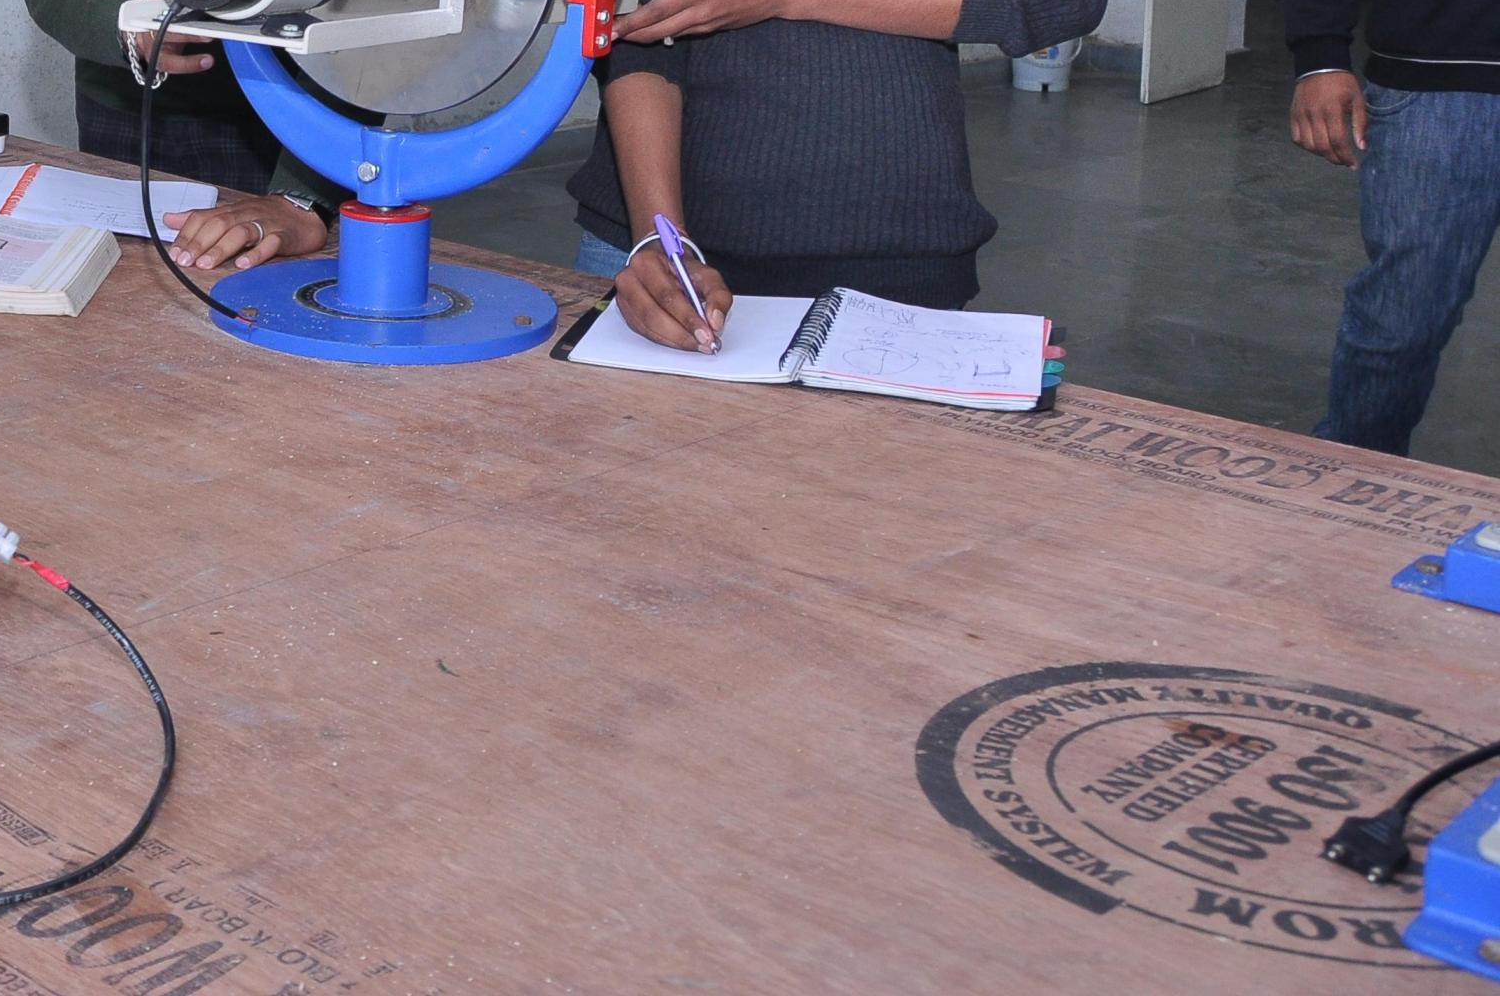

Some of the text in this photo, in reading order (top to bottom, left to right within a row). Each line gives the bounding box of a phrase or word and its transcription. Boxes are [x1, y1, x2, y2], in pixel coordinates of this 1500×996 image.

[1123, 431, 1323, 490] WOOD
[1135, 457, 1217, 482] BOARD
[973, 685, 1142, 784] MANAGEMENT
[1080, 720, 1227, 805] COMPANY
[1121, 734, 1277, 823] CERTIFIED
[982, 786, 1132, 886] SYSTEM
[1160, 796, 1312, 874] 9001
